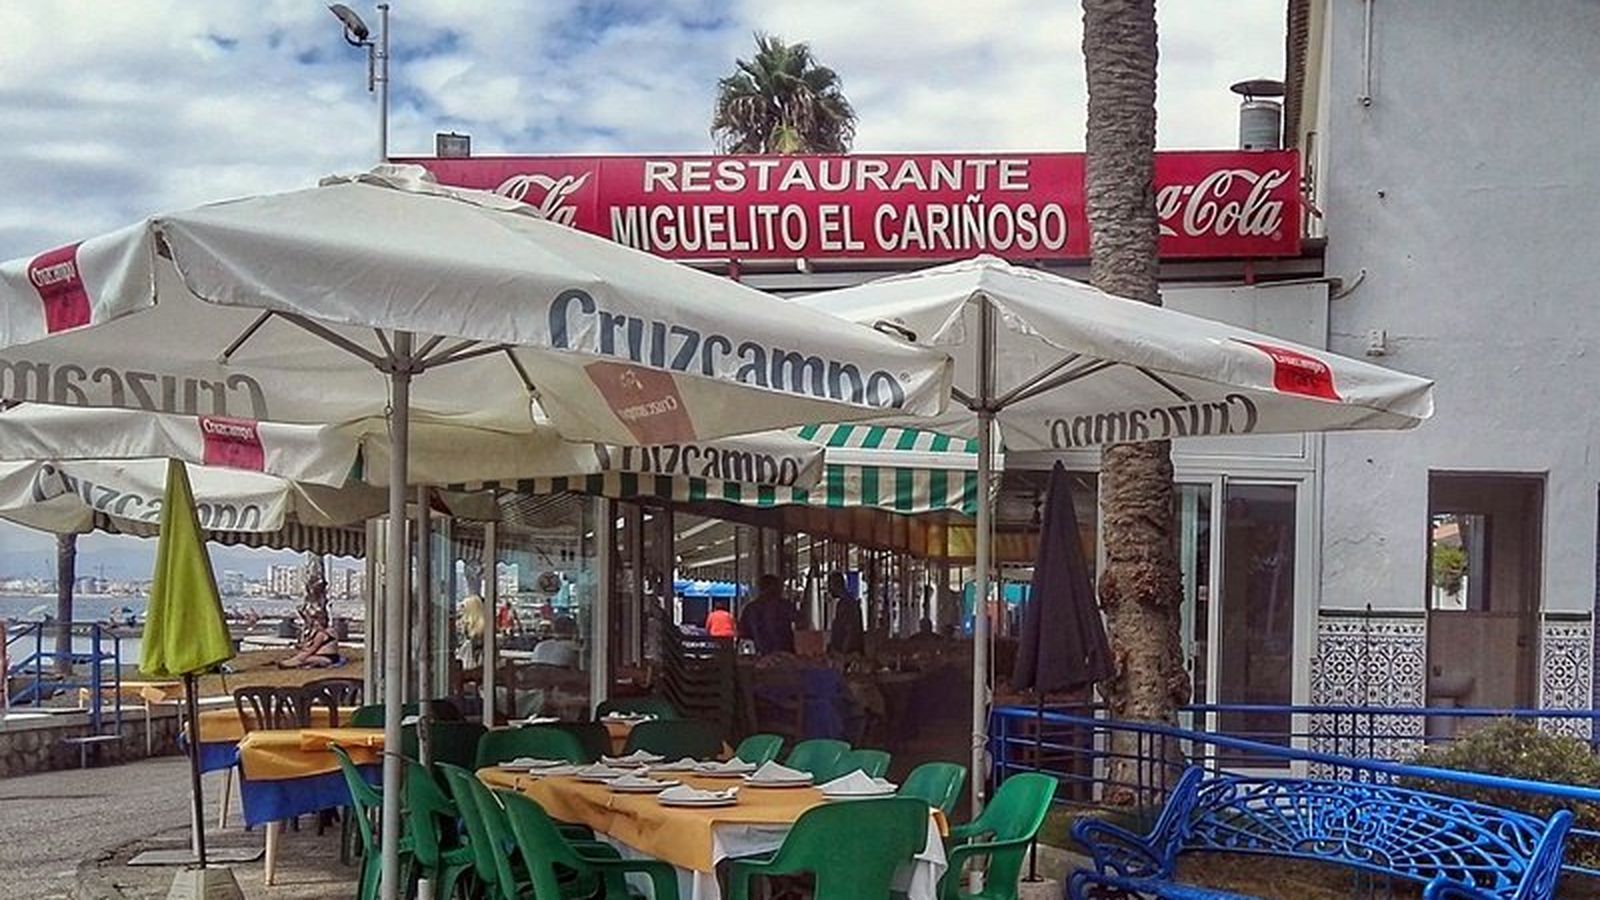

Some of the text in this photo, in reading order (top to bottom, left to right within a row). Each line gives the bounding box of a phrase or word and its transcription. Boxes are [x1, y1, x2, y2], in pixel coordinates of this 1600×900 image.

[644, 160, 1030, 193] RESTAURANTE
[1156, 169, 1292, 239] a-Cola
[609, 195, 1067, 252] MIGUELITO EL CARIÑOSO
[548, 288, 905, 410] Cruzcampo
